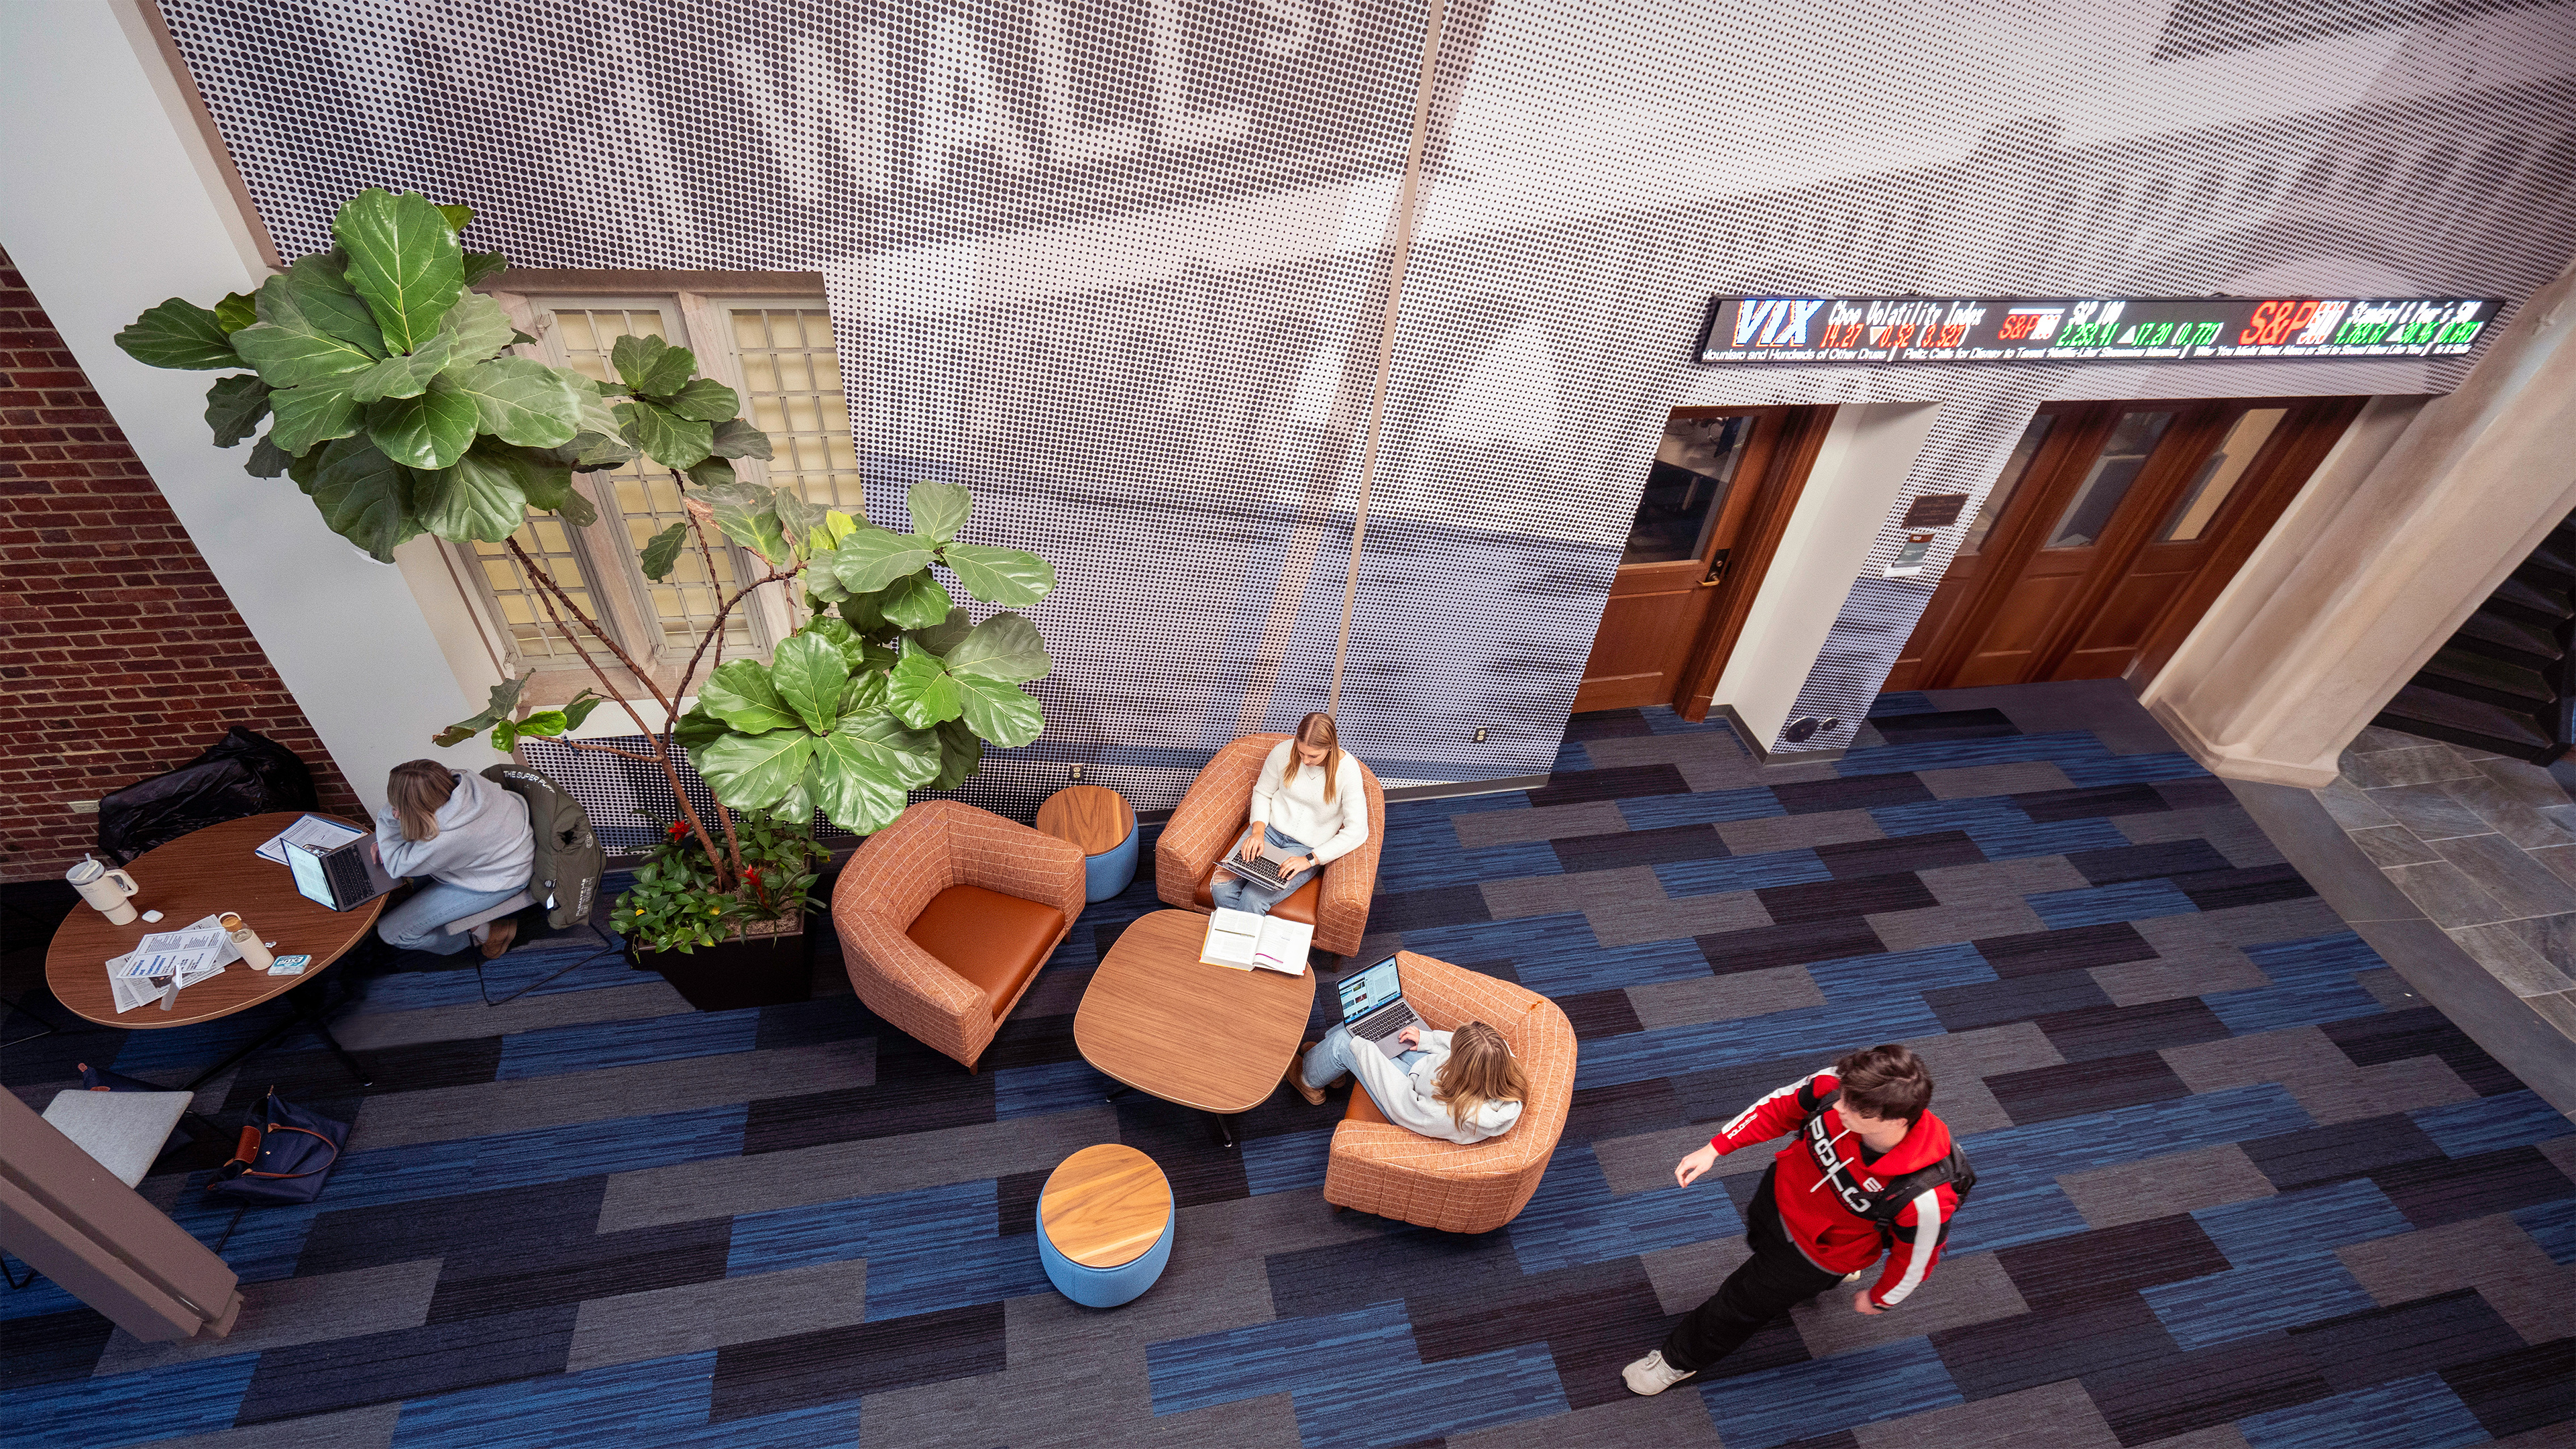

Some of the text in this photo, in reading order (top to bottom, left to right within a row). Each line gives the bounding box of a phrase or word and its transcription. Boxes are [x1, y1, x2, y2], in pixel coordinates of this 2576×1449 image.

[726, 0, 1250, 205] WALL
[1732, 299, 1825, 347] VIX
[1828, 301, 1986, 326] Cboe Volatility Index
[2096, 301, 2126, 325] 100
[2346, 301, 2408, 324] Standard
[1820, 323, 1864, 348] 14.27
[1917, 323, 1970, 348] (3.52%)
[2171, 322, 2224, 346] (0.77%)
[1747, 350, 1769, 360] and
[1768, 349, 1815, 360] Hundreds
[1816, 349, 1830, 360] of
[1829, 348, 1858, 360] Other
[1954, 348, 1971, 359] for
[503, 770, 517, 778] THE
[516, 771, 539, 782] SUPER
[537, 779, 555, 794] PUFF
[576, 890, 584, 917] CLIMATE
[277, 956, 304, 965] Extra
